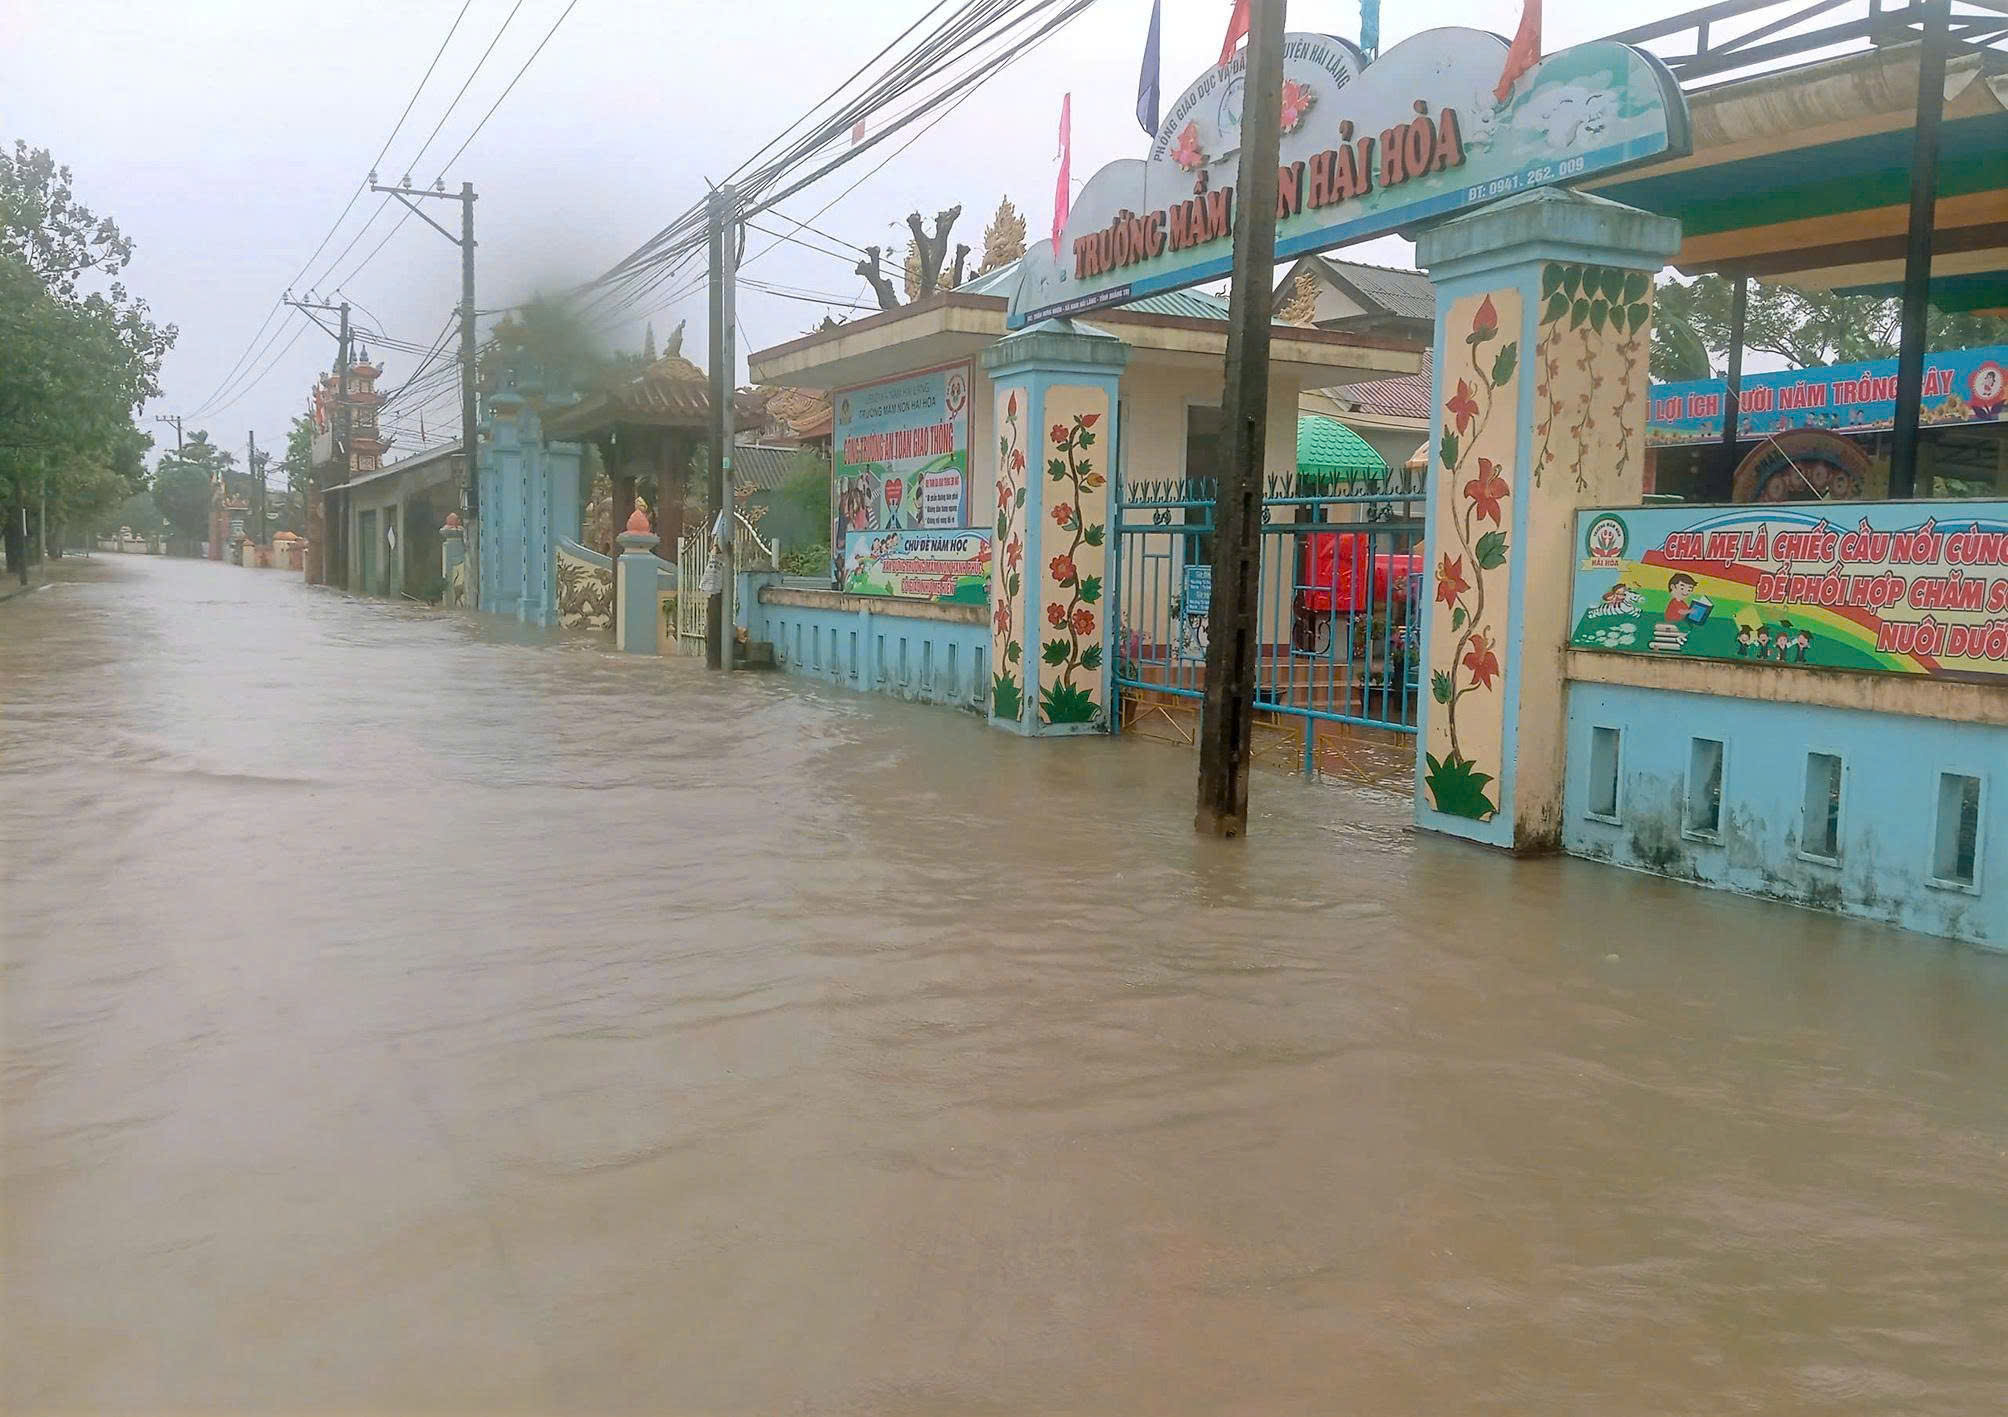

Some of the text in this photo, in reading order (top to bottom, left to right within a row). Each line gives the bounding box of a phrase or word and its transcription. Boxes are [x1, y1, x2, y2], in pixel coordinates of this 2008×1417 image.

[1176, 93, 1197, 121] GIÁO
[1198, 74, 1216, 98] DỤC
[1283, 38, 1310, 63] UYỆN
[1326, 54, 1350, 90] LĂNG
[1073, 209, 1167, 279] TRƯỜNG
[1168, 170, 1233, 252] MẦM
[1307, 120, 1375, 209] HẢI
[1379, 100, 1466, 187] HÒA
[1489, 175, 1523, 195] 0941.
[1527, 166, 1555, 185] 262.
[1559, 156, 1584, 175] 009
[1656, 396, 1683, 424] LỢI
[1687, 392, 1718, 418] ÍCH
[1723, 384, 1773, 414] ƯỜI
[1778, 380, 1826, 410] NĂM
[1922, 365, 1955, 397] ÂY
[913, 426, 929, 457] GIAO
[931, 536, 951, 552] NĂM
[951, 539, 968, 556] HỌC
[1664, 531, 1704, 560] CHA
[1705, 531, 1741, 569] MẸ
[1739, 521, 1768, 561] LÀ
[1772, 517, 1838, 562] CHIẾC
[1839, 516, 1891, 563] CẦU
[1890, 516, 1944, 564] NỐI
[1756, 561, 2008, 615] ĐỂ PHỐI HỢP CHĂM S
[1875, 613, 2008, 661] NUÔI DƯỠ
